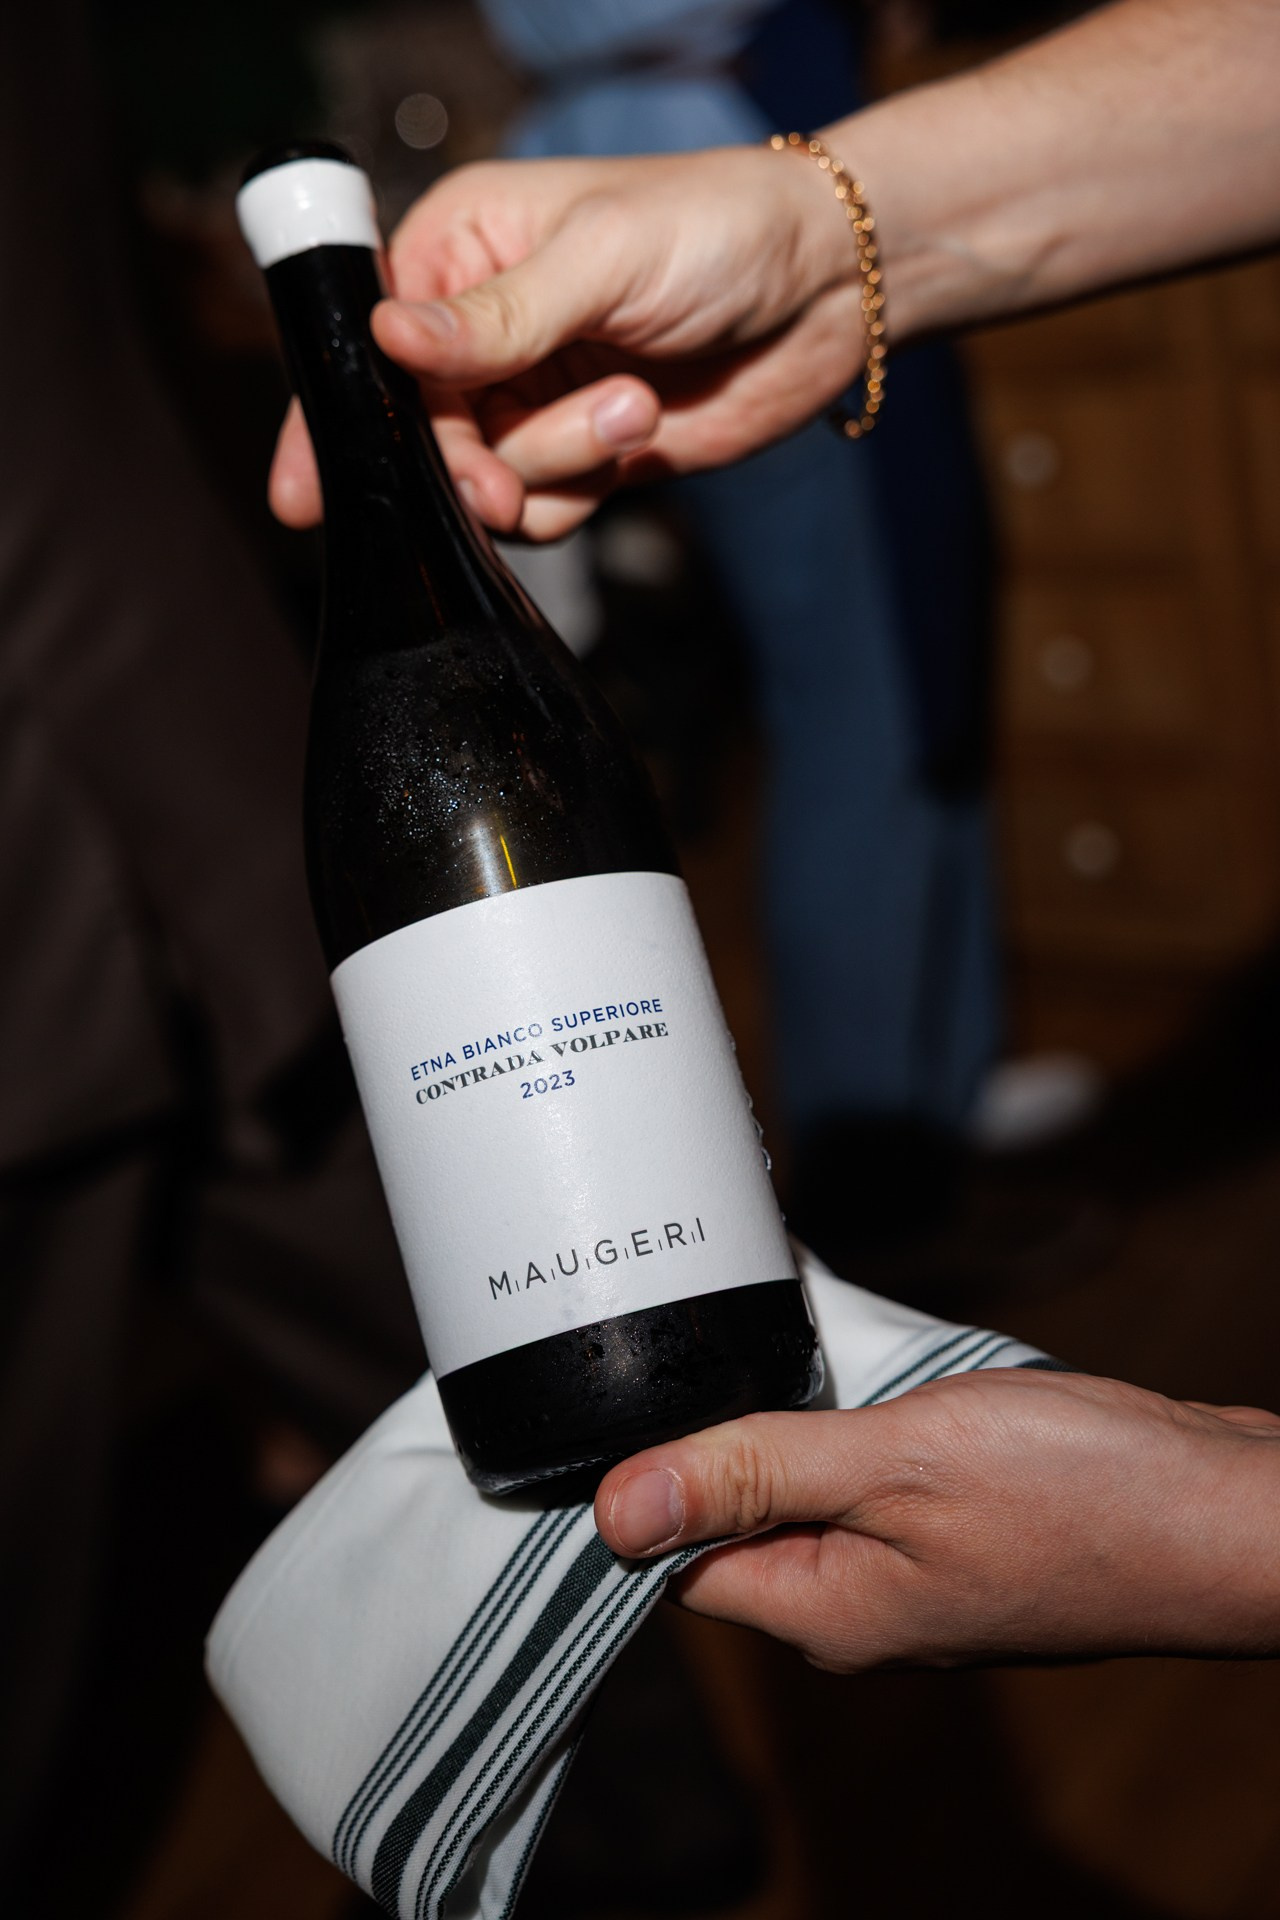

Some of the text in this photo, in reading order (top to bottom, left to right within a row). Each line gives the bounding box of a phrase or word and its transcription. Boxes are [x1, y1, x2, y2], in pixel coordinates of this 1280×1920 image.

[410, 998, 664, 1082] ETNA BIANCO SUPERIORE
[415, 1021, 669, 1105] CONTRADA VOLPARE
[519, 1069, 576, 1100] 2023
